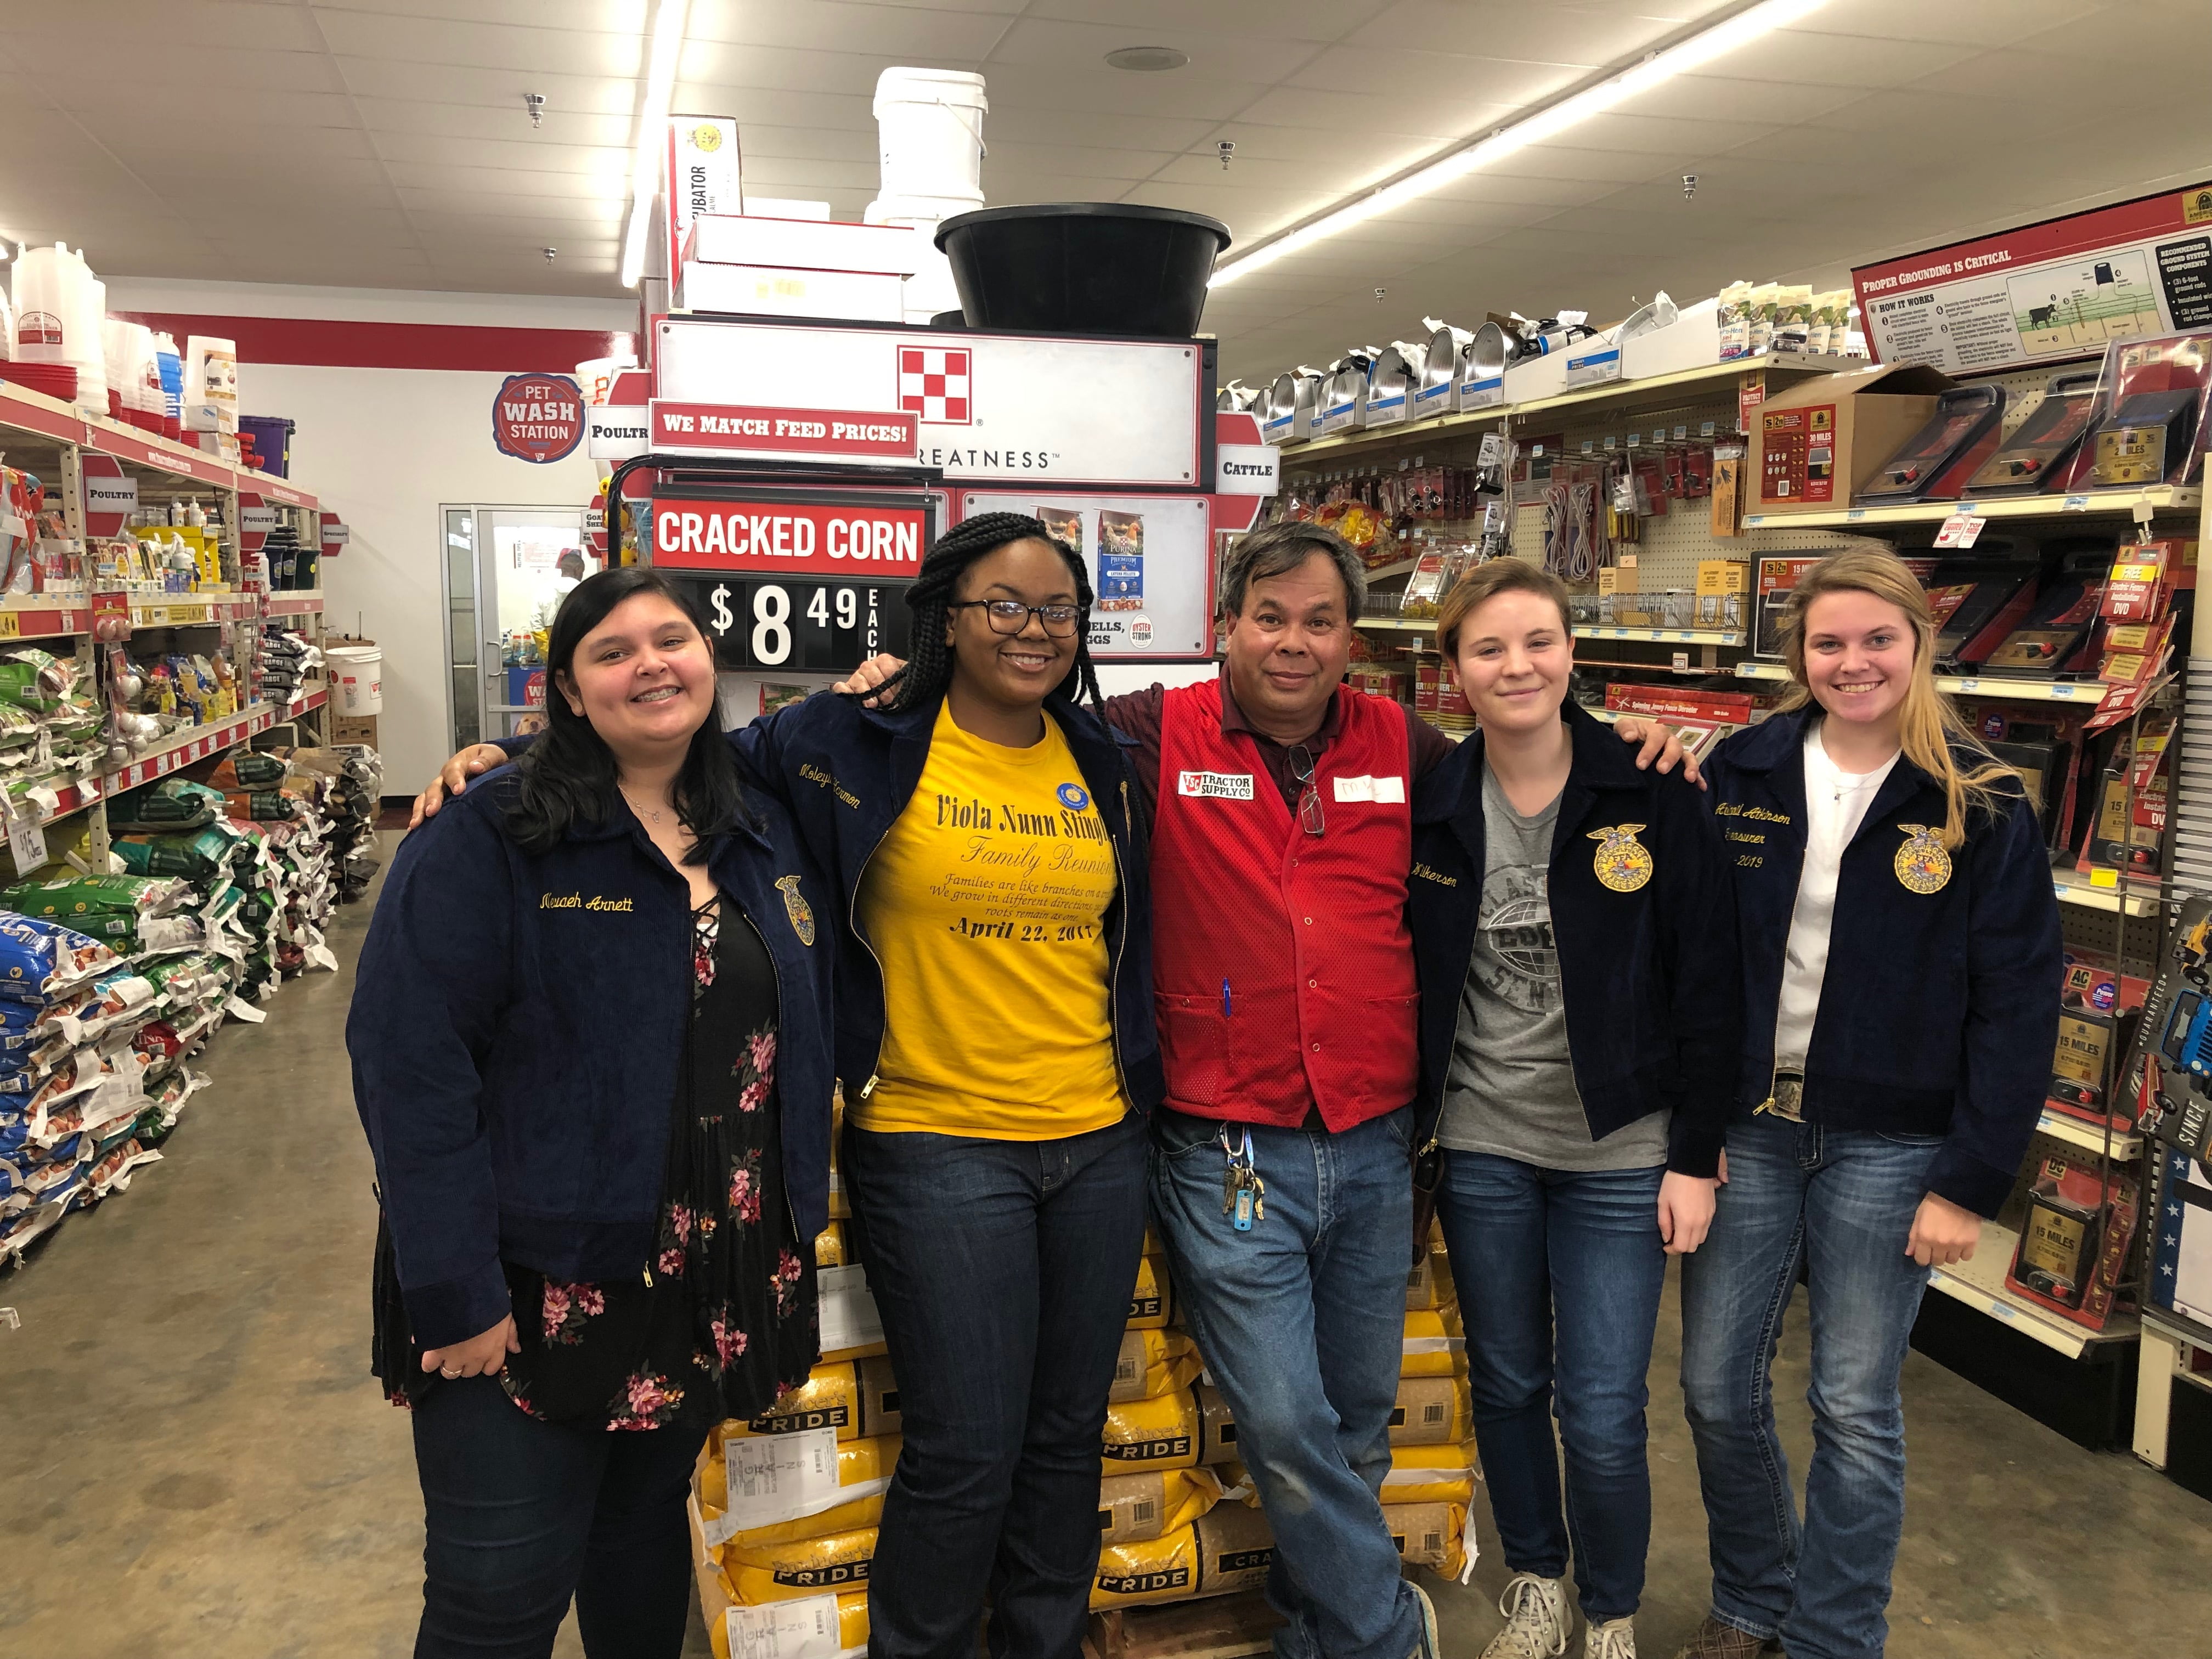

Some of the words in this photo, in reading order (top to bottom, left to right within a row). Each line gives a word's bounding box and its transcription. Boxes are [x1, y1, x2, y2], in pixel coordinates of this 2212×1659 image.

[691, 166, 706, 219] UBATOR
[2160, 255, 2185, 266] GROUND
[2186, 250, 2210, 261] SYSTEM
[1862, 276, 1898, 294] PROPER
[1899, 264, 1951, 285] GROUNDING
[1954, 262, 1963, 272] IS
[1965, 250, 2011, 270] CRITICAL
[1879, 302, 1896, 313] HOW
[1898, 299, 1905, 308] IT
[1907, 294, 1934, 307] WORKS
[526, 386, 551, 399] PET
[503, 402, 575, 422] WASH
[511, 425, 568, 439] STATION
[592, 425, 648, 438] POULTR
[663, 414, 694, 432] WE
[699, 415, 769, 436] MATCH
[775, 419, 826, 439] FEED
[832, 422, 907, 442] PRICES!
[1816, 432, 1831, 442] MILES
[918, 449, 1048, 469] REATNESS
[1223, 461, 1273, 477] CATTLE
[90, 489, 134, 499] POULTRY
[658, 511, 815, 557] CRACKED
[827, 518, 917, 562] CORN
[1110, 544, 1137, 554] PURINA
[1793, 565, 1800, 573] 15
[2122, 567, 2142, 579] FREE
[2113, 602, 2130, 615] DVD
[1089, 622, 1125, 633] ELLS,
[1132, 623, 1151, 631] OYSTER
[1086, 635, 1111, 645] GGS
[1132, 631, 1152, 641] STRONG
[2107, 696, 2125, 708] DVD
[1185, 775, 1200, 791] TSC
[1202, 774, 1250, 788] TRACTOR
[1201, 785, 1238, 797] SUPPLY
[2111, 801, 2122, 811] 15
[2144, 802, 2166, 812] Install
[936, 794, 992, 830] Viola
[999, 804, 1058, 838] Nunn
[1742, 807, 1791, 825] Atkinson
[2151, 812, 2165, 826] DV
[961, 836, 1041, 878] Family
[1048, 844, 1113, 875] Reunion
[945, 873, 995, 889] Families
[998, 882, 1015, 890] are
[1019, 880, 1039, 894] like
[1042, 881, 1083, 898] branches
[1085, 890, 1094, 898] on
[586, 895, 634, 912] Arnett
[930, 885, 949, 897] We
[950, 890, 985, 901] grow
[988, 891, 998, 902] in
[1002, 893, 1048, 908] different
[985, 907, 1013, 917] roots
[1015, 910, 1049, 920] remain
[949, 917, 1014, 939] April
[1020, 925, 1048, 944] 22,
[1057, 925, 1093, 942] 2017
[2072, 969, 2089, 984] AC
[2097, 988, 2114, 997] Power
[2140, 979, 2167, 1041] GUARANTEED
[2059, 1036, 2069, 1046] 15
[2071, 1039, 2099, 1056] MILES
[2179, 1100, 2205, 1147] SINCE
[2036, 1226, 2046, 1237] 15
[2047, 1231, 2075, 1250] MILES
[1103, 1440, 1187, 1458] PRIDE
[1235, 1552, 1272, 1566] CRA
